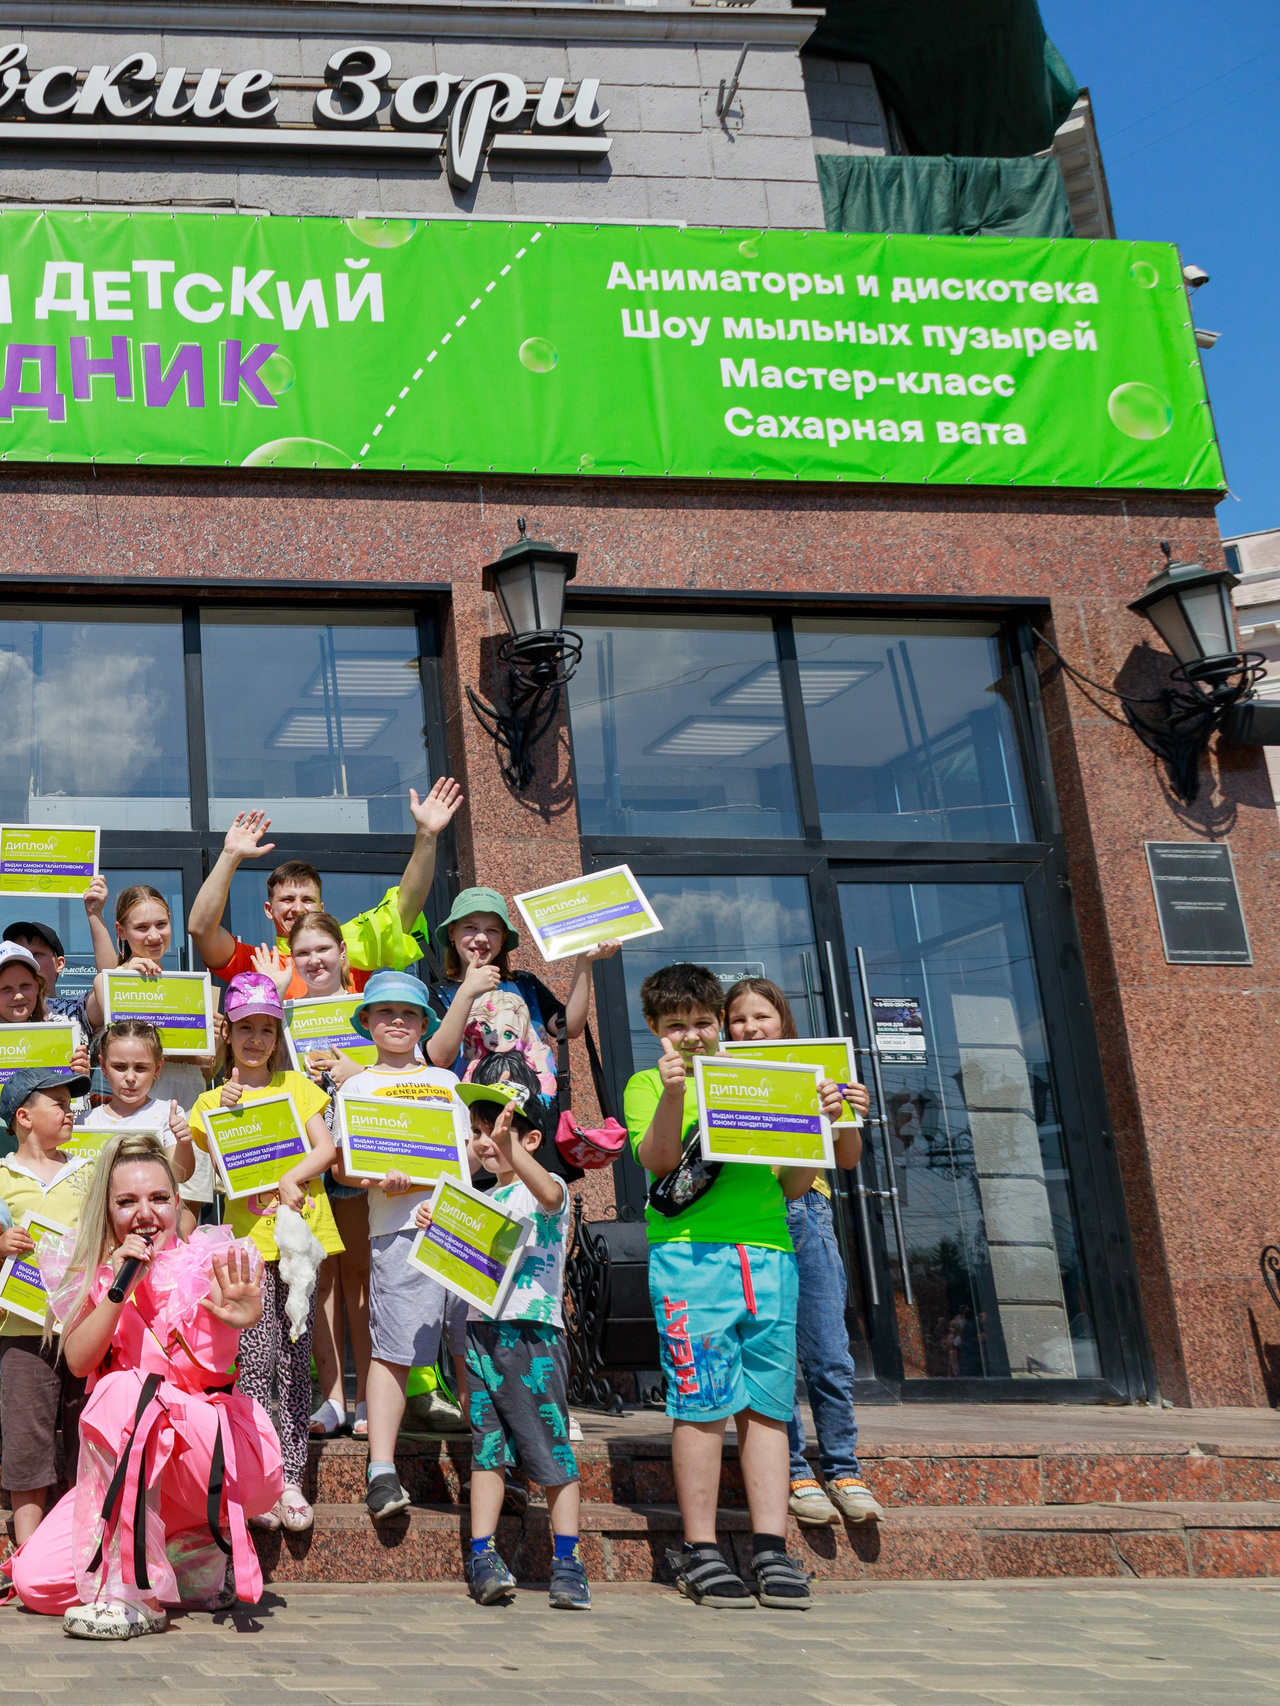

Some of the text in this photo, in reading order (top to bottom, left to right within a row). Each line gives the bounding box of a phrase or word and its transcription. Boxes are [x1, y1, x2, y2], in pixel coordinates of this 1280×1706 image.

[316, 45, 611, 184] Зори
[607, 260, 1099, 305] Аниматоры и дискотека
[35, 257, 384, 330] ДЕТСКИЙ
[621, 308, 1098, 358] Шоу мыльных пузырей
[720, 358, 1016, 399] Мастер-класс
[724, 407, 1027, 447] Сахарная вата
[5, 842, 54, 852] ДИПЛОМ
[113, 991, 164, 1002] ДИПЛОМ
[385, 1088, 447, 1097] GENERATION
[708, 1083, 769, 1099] ДИПЛОМ
[350, 1115, 408, 1130] ДИПЛОМ
[712, 1119, 773, 1129] ЮНОМУ КОНДИТЕРУ
[734, 1114, 762, 1122] САМОМУ
[761, 1116, 810, 1125] ТАЛАНТЛИВОМУ
[216, 1123, 263, 1142] ДИПЛОМ
[663, 1296, 699, 1395] HEAT
